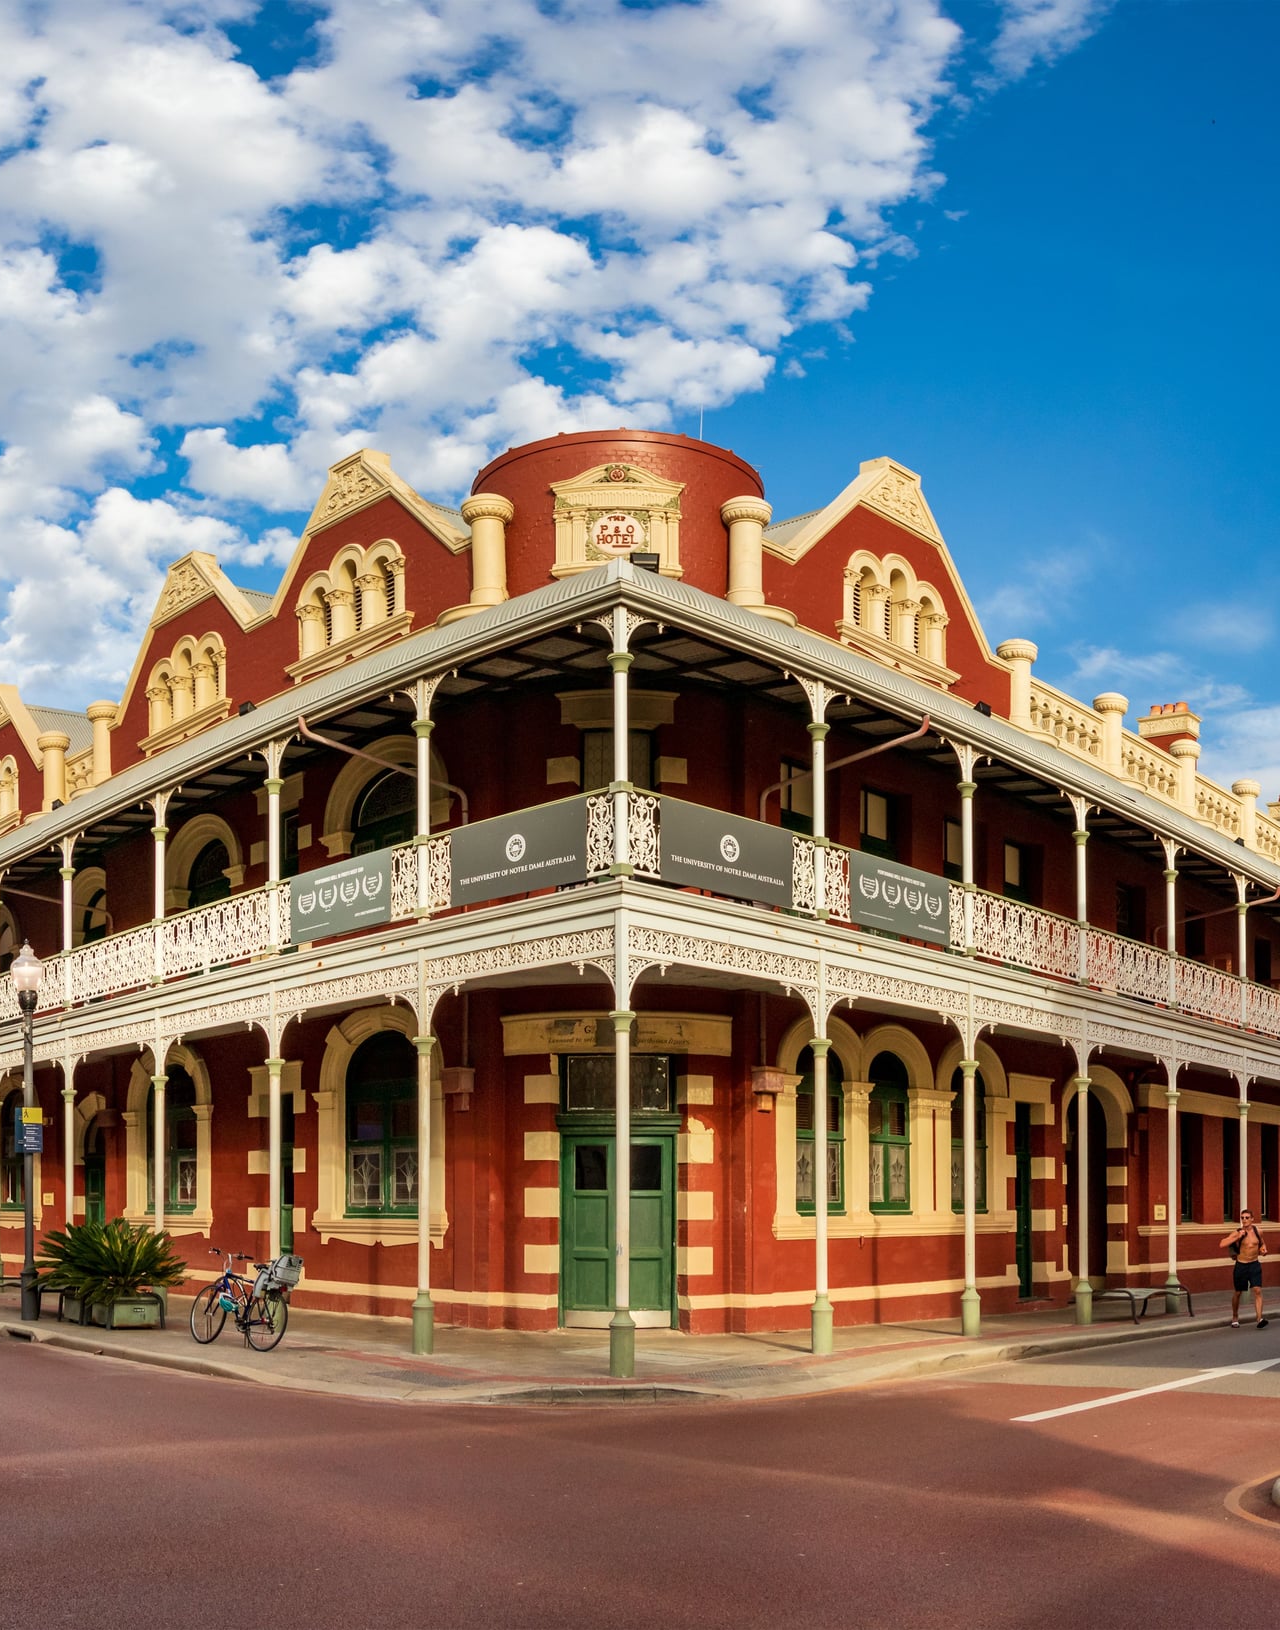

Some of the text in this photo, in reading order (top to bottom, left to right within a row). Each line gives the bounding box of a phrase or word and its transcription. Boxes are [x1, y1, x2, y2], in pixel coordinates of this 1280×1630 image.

[596, 534, 639, 544] HOTEL
[600, 525, 608, 534] P
[626, 524, 634, 534] O
[459, 878, 470, 886] THE
[470, 872, 500, 884] UNIVERSITY
[509, 864, 528, 875] NOTRE
[528, 861, 545, 871] DAME
[545, 854, 576, 867] AUSTRALIA
[671, 854, 682, 863] THE
[683, 857, 715, 871] UNIVERSITY
[723, 867, 741, 877] NOTRE
[742, 871, 757, 880] DAME
[757, 875, 784, 887] AUSTRALIA
